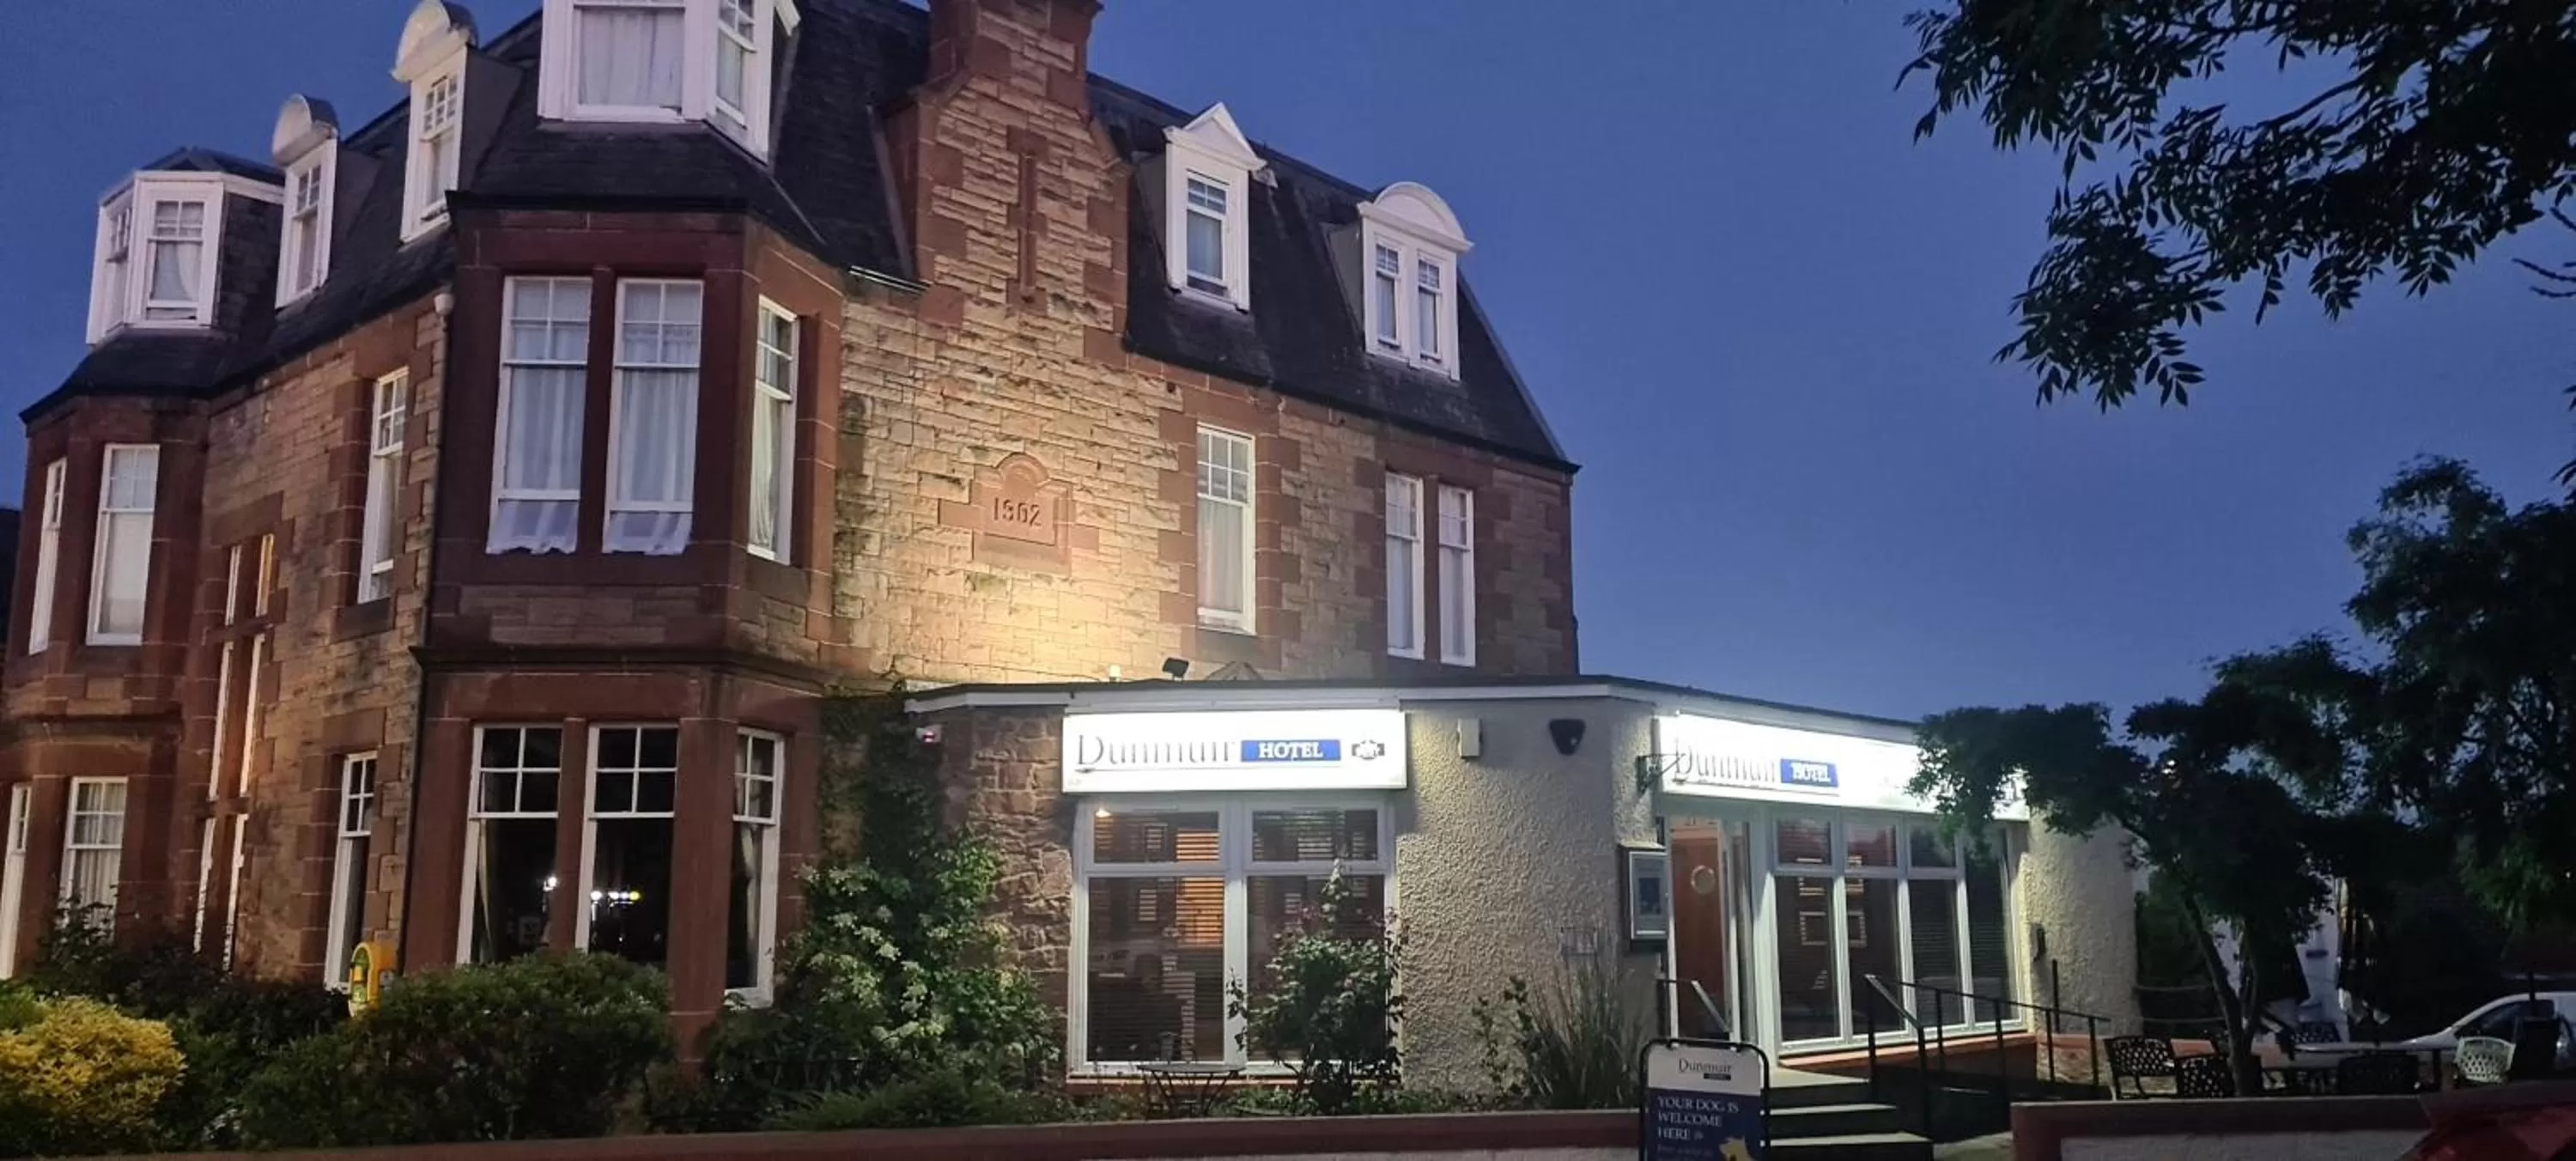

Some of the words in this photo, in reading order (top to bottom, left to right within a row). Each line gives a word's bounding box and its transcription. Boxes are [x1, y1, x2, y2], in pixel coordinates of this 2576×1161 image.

[1078, 734, 1236, 765] Dunmuir
[1258, 741, 1324, 762] HOTEL
[1656, 1096, 1694, 1110] YOUR
[1696, 1098, 1725, 1113] DOG
[1728, 1102, 1739, 1113] IS
[1657, 1112, 1722, 1128] WELCOME
[1656, 1126, 1691, 1140] HERE
